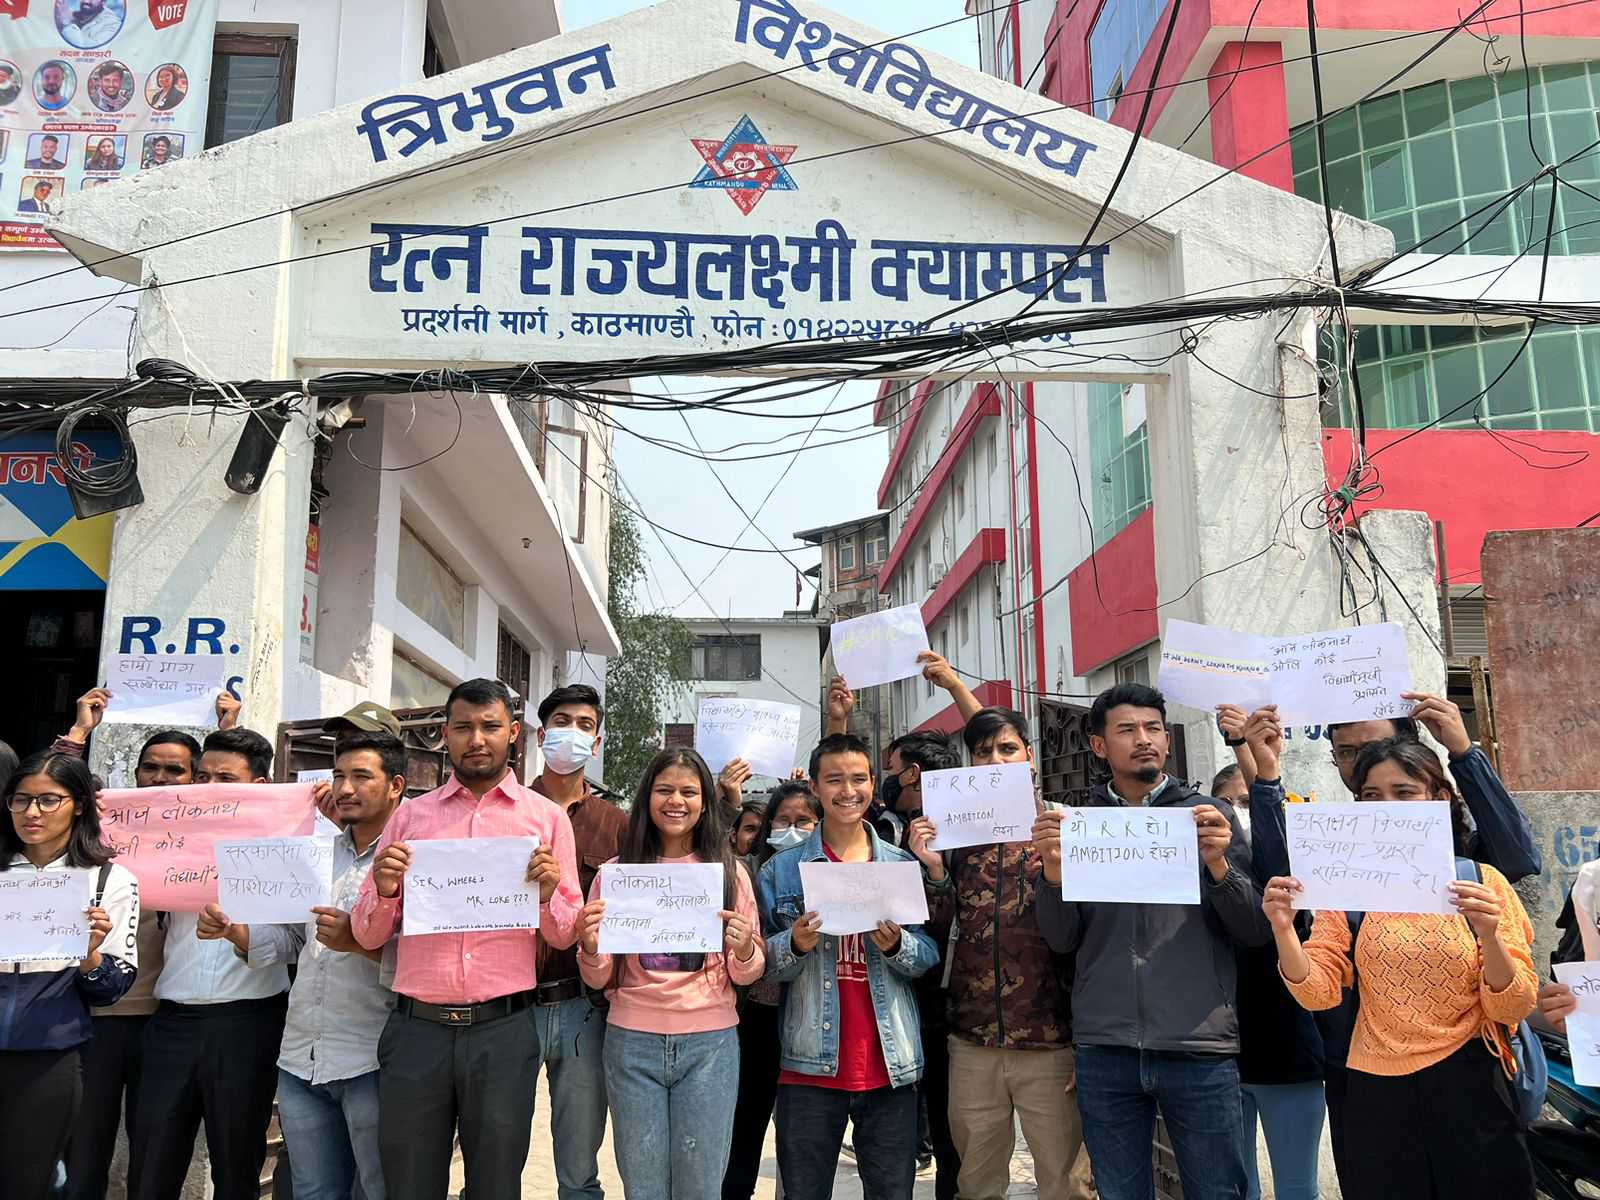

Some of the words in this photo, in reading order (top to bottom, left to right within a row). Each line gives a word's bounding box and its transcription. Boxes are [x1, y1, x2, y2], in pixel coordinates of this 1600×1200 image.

[158, 4, 184, 22] VOTE
[735, 0, 1098, 178] विश्वविद्यालय
[356, 43, 617, 163] त्रिभुवन
[369, 223, 489, 294] रत्न
[520, 219, 857, 309] राज्यलक्ष्मी
[871, 239, 1110, 303] क्याम्पस
[401, 304, 490, 337] प्रदर्शनी
[950, 775, 961, 793] R
[968, 775, 980, 793] R
[162, 794, 240, 819] लोकनाथ
[944, 808, 995, 827] AMBITION
[1070, 810, 1087, 840] यो
[1101, 820, 1116, 838] R
[1125, 820, 1139, 838] R
[1069, 845, 1144, 864] AMBITION
[611, 867, 673, 893] लोकनाथ
